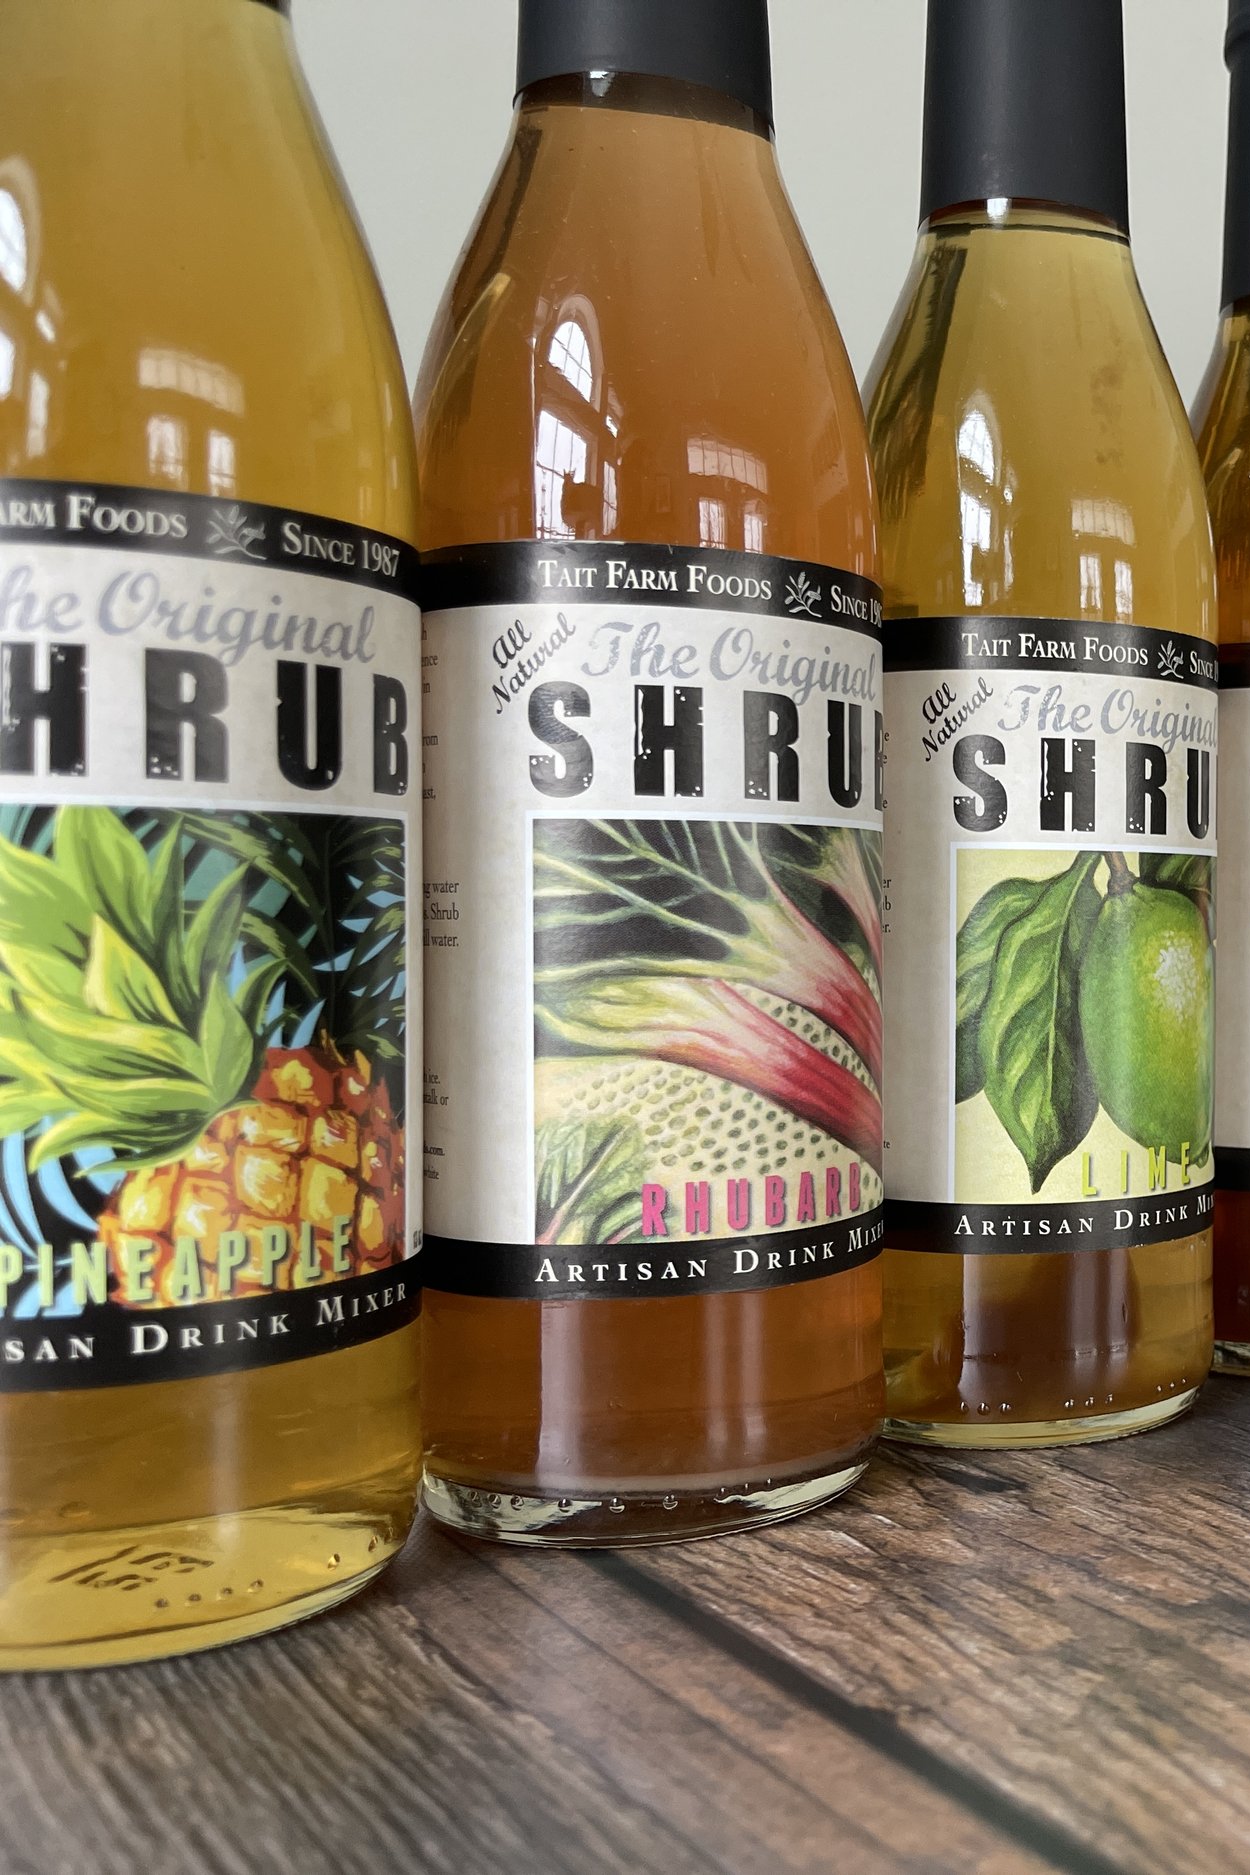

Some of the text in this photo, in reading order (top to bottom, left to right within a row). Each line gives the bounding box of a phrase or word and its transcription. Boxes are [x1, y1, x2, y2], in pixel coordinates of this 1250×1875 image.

[65, 493, 188, 538] FOODS
[281, 521, 355, 566] SINCE
[361, 539, 401, 578] 1987
[98, 570, 376, 667] Original
[538, 560, 597, 588] TAIT
[606, 561, 677, 592] FARM
[686, 565, 772, 601] FOODS
[830, 584, 868, 621] SINCE
[490, 613, 577, 714] Natural
[492, 619, 532, 670] All
[581, 622, 876, 706] The Original
[962, 633, 1011, 657] TAIT
[1018, 633, 1075, 659] FARM
[1083, 636, 1149, 666] FOODS
[922, 682, 956, 725] All
[922, 676, 994, 762] Natural
[997, 684, 1095, 733] The
[952, 734, 1217, 841] SHRU
[430, 902, 459, 920] Shrub
[432, 881, 459, 894] water
[641, 1162, 862, 1237] RHUBARB
[1082, 1141, 1191, 1197] LIME
[955, 1215, 1095, 1236] ARTISAN
[1114, 1204, 1189, 1231] DRINK
[0, 1214, 352, 1310] PINEAPPLE
[535, 1258, 708, 1282] ARTISAN
[733, 1241, 835, 1275] DRINK
[130, 1313, 291, 1355] DRINK
[316, 1282, 407, 1327] MIXER
